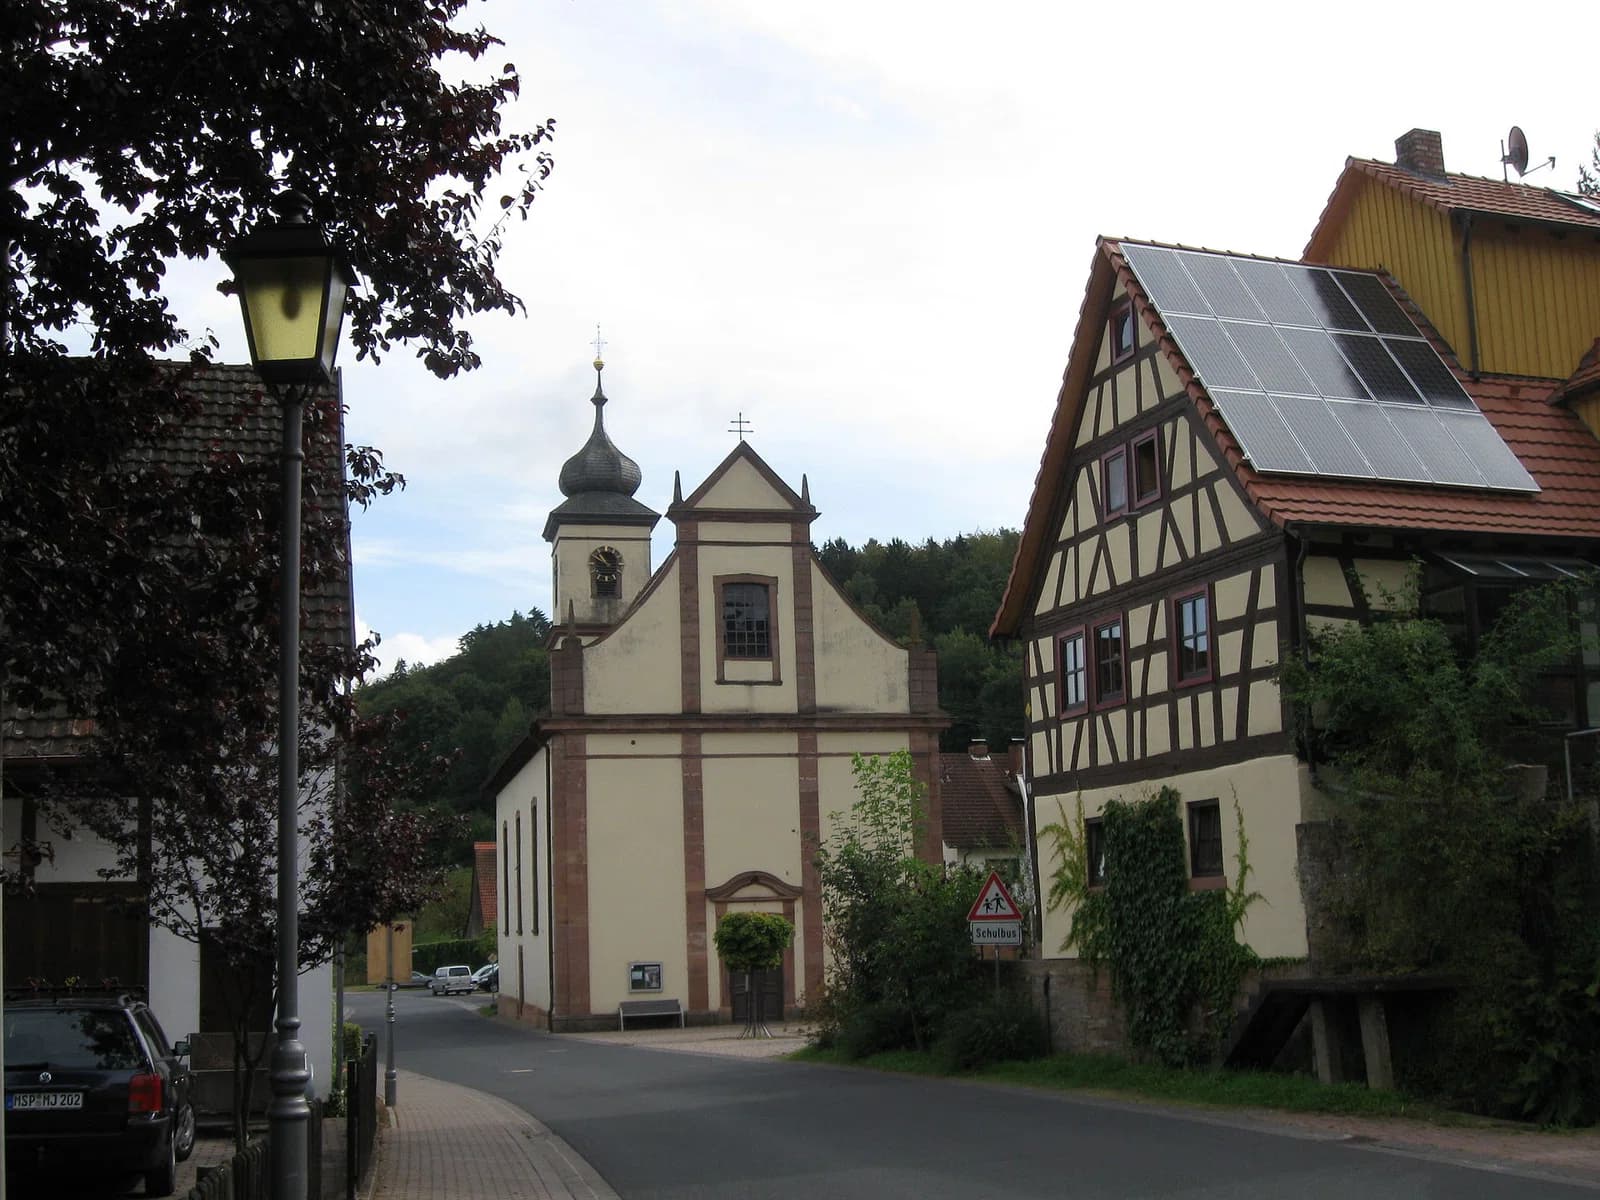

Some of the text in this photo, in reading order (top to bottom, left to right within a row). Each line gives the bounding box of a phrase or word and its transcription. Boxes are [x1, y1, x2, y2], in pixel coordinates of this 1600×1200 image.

[976, 927, 1017, 938] Schulbus
[14, 1094, 81, 1107] MSP MJ 202
